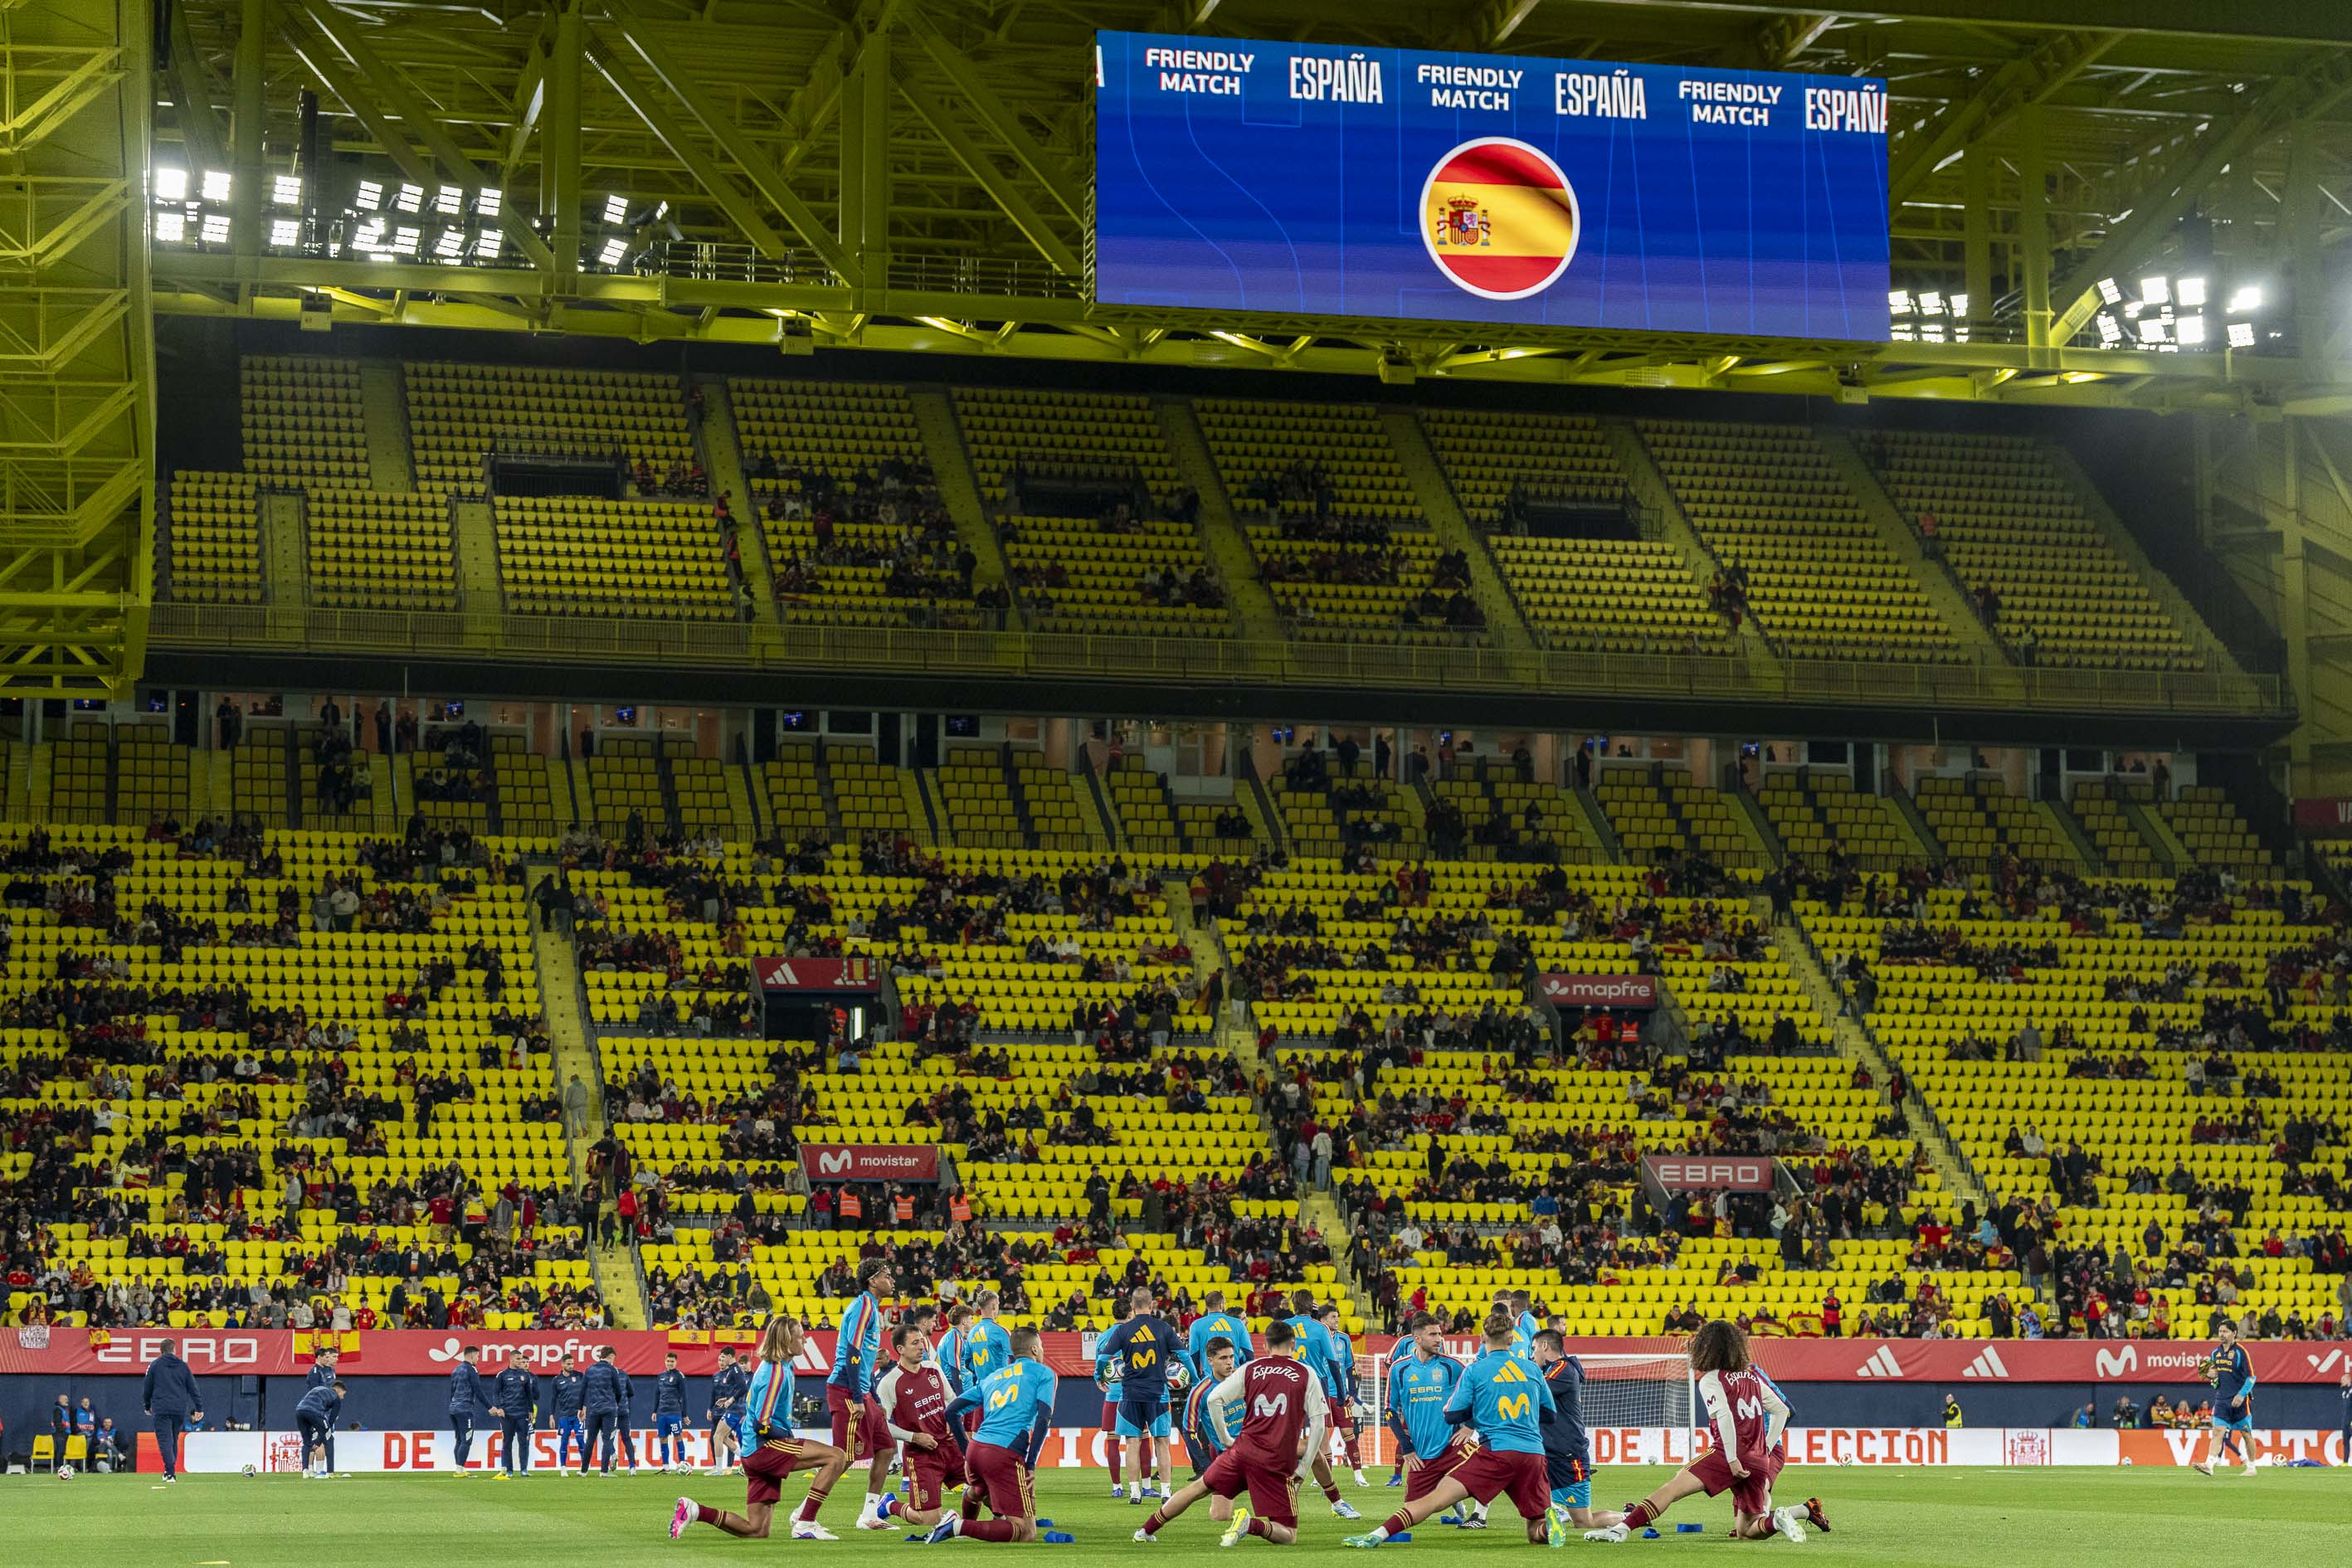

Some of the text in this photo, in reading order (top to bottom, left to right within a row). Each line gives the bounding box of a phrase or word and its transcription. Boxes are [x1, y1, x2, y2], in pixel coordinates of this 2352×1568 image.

[1146, 48, 1254, 73] FRIENDLY
[1160, 71, 1241, 95] MATCH
[1289, 53, 1384, 105] ESPAÑA
[1417, 64, 1523, 90] FRIENDLY
[1431, 88, 1510, 111] MATCH
[1555, 70, 1647, 120] ESPAÑA
[1678, 80, 1782, 105] FRIENDLY
[1692, 104, 1769, 127] MATCH
[1572, 981, 1651, 1000] mapfre
[859, 1154, 919, 1167] movistar
[1659, 1164, 1760, 1183] EBRO
[1253, 1365, 1301, 1382] España
[914, 1393, 941, 1409] EBRO
[1409, 1385, 1443, 1395] EBRO
[382, 1432, 436, 1469] DE
[1595, 1429, 1640, 1463] DE
